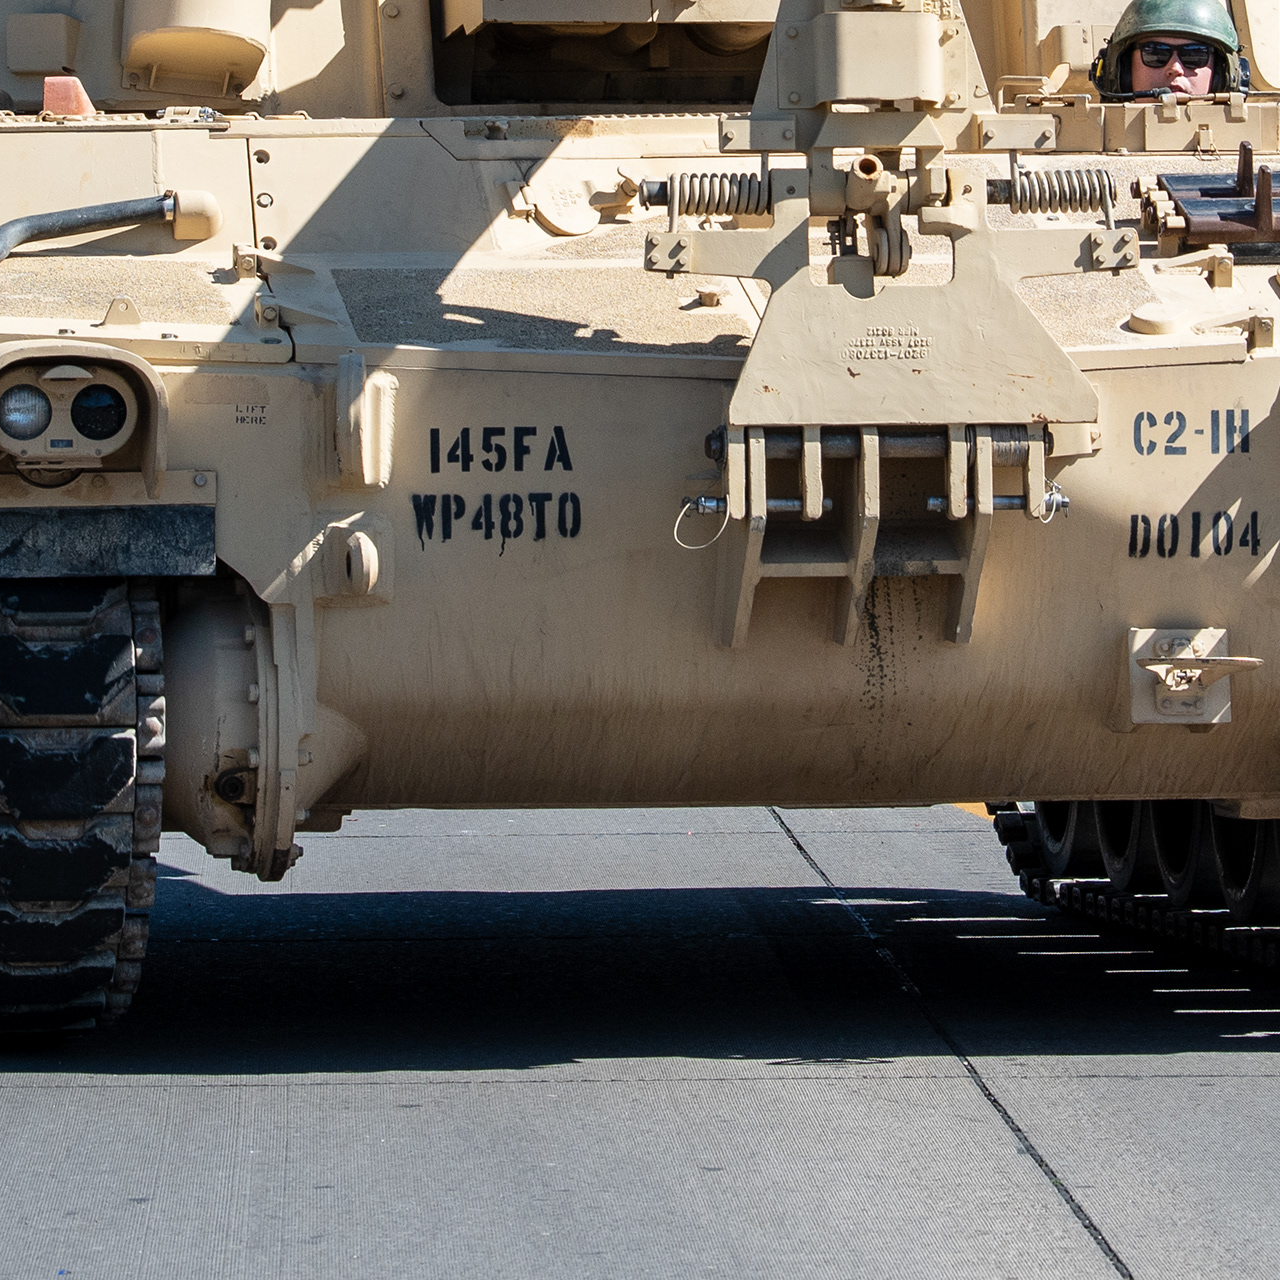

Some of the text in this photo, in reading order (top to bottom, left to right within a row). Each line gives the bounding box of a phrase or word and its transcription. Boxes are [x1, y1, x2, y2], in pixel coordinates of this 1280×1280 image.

[235, 404, 267, 414] LIFT
[235, 415, 267, 425] HERE
[429, 425, 574, 473] 145FA
